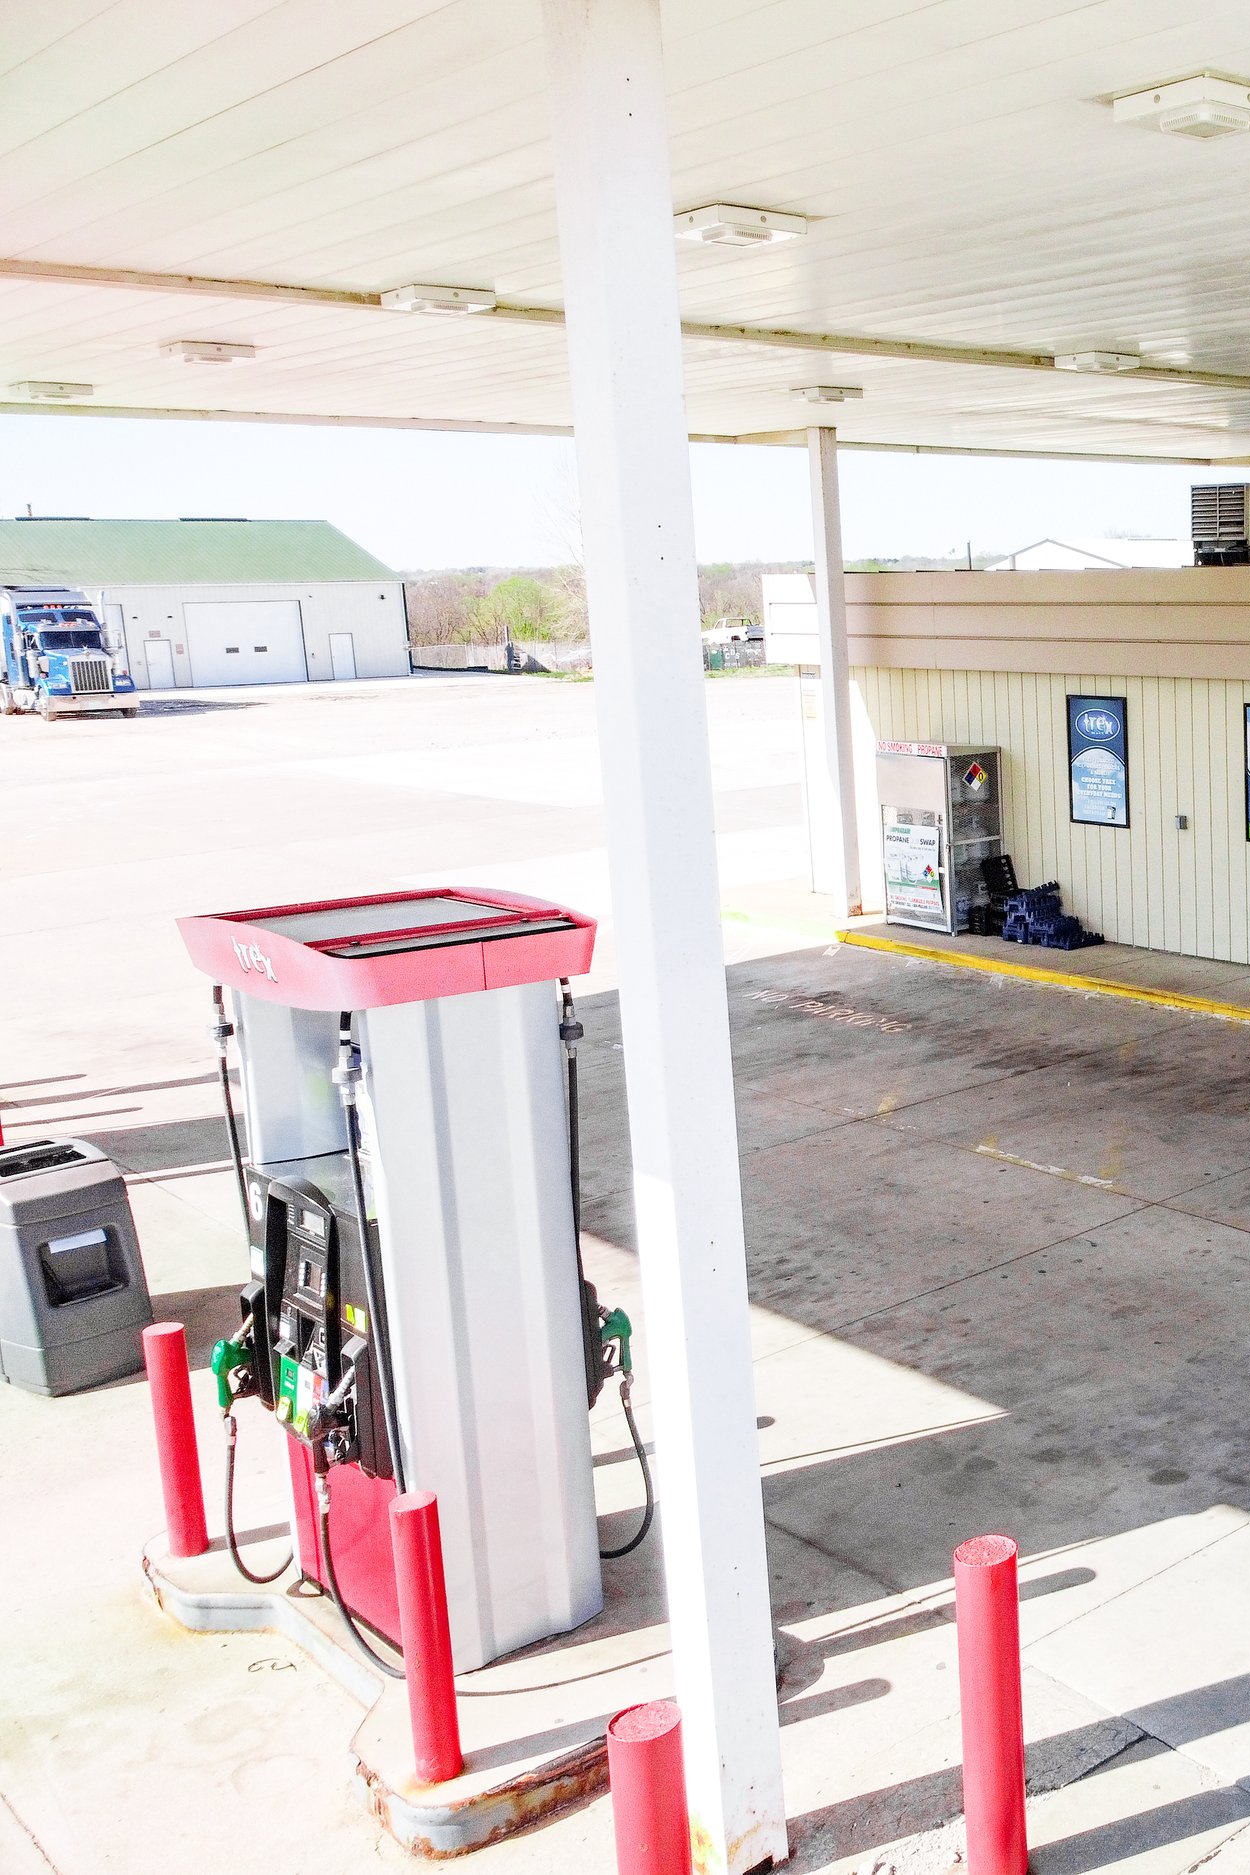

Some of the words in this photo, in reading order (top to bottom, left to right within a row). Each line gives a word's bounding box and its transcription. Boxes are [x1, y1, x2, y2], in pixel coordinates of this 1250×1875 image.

[1083, 713, 1113, 735] trex
[878, 741, 887, 752] NO
[887, 742, 913, 754] SMOKING
[917, 744, 943, 756] PROPANE
[886, 834, 910, 844] PROPANE
[919, 838, 936, 846] SWAP
[231, 936, 279, 984] trex
[249, 1181, 263, 1221] 6
